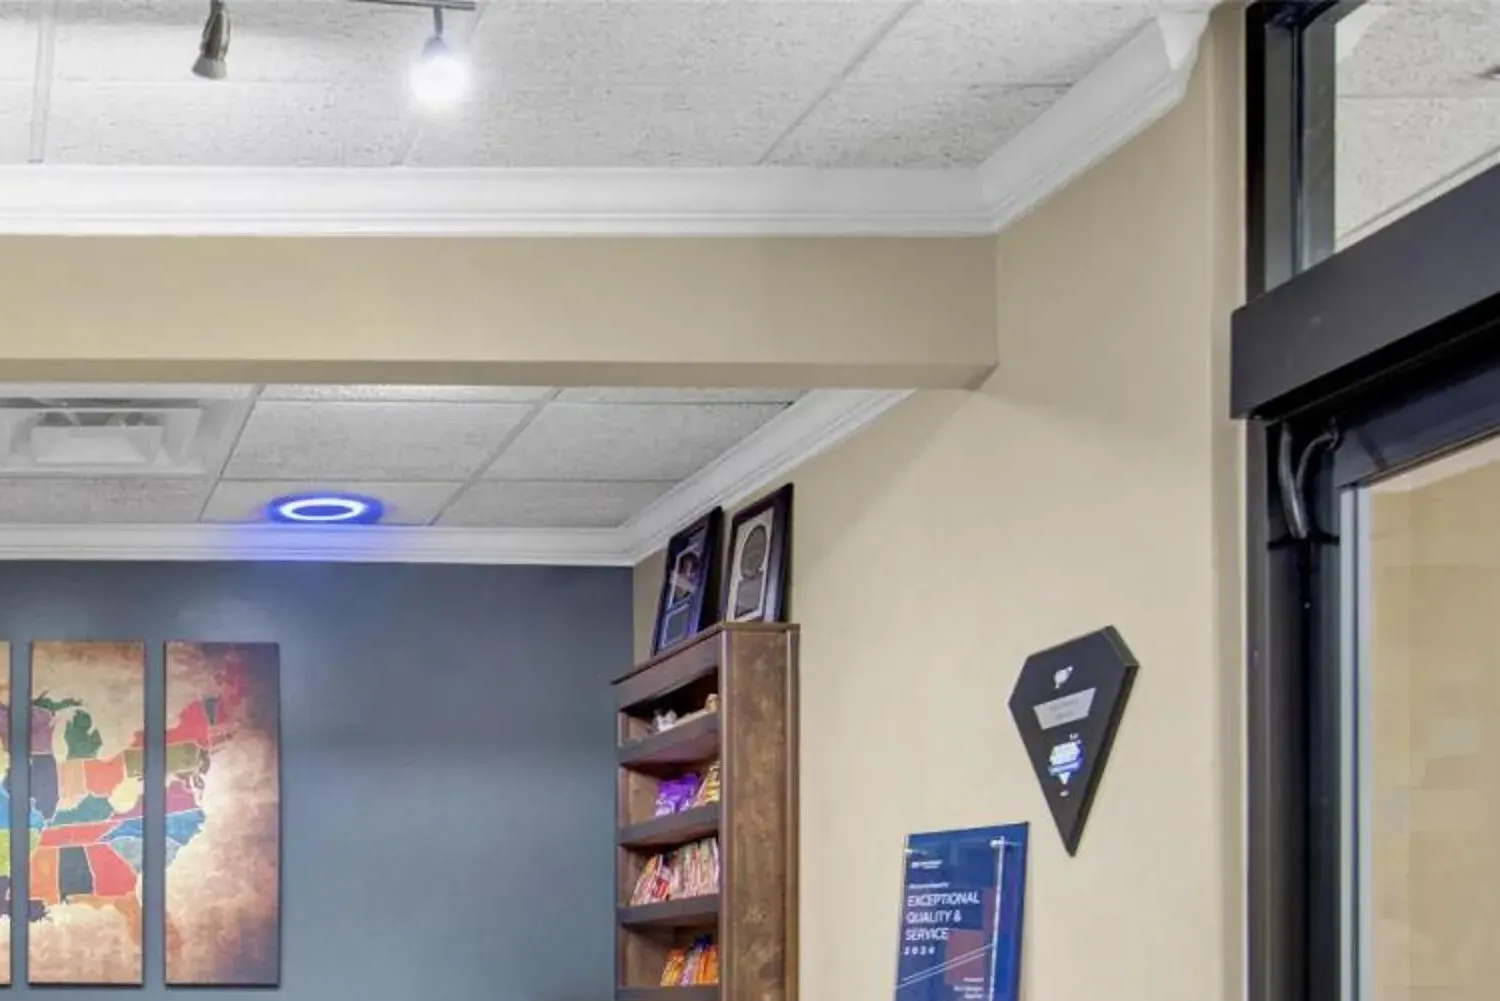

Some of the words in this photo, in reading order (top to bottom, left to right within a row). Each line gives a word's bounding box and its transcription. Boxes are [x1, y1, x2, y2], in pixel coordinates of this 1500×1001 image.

[907, 891, 981, 907] EXCEPTIONAL
[906, 909, 952, 925] QUALITY
[953, 909, 962, 923] &
[905, 927, 949, 942] SERVICE
